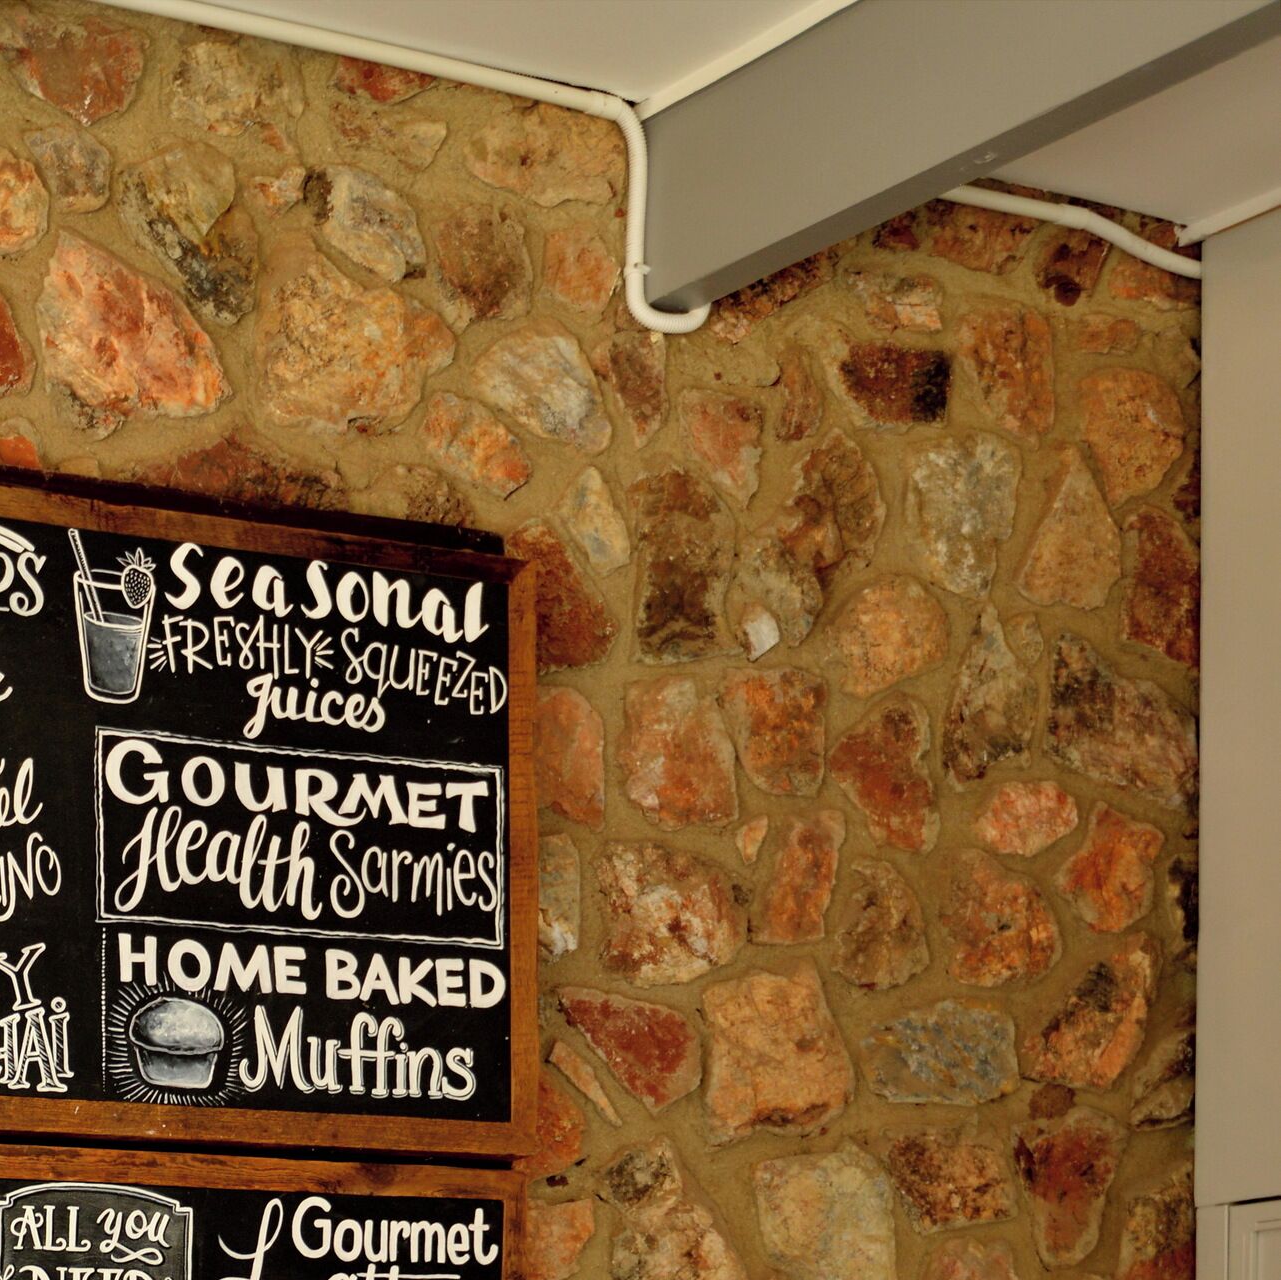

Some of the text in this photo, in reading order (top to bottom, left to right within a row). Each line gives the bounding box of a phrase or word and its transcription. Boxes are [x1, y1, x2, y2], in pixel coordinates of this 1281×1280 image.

[162, 615, 324, 679] FRESHLY
[105, 740, 489, 833] GOURMET
[114, 805, 499, 920] Health Sarmies
[118, 932, 506, 1009] HOME BAKED
[239, 1005, 476, 1100] Muffins
[9, 1205, 170, 1266] ALL you
[292, 1196, 499, 1265] Gourmet
